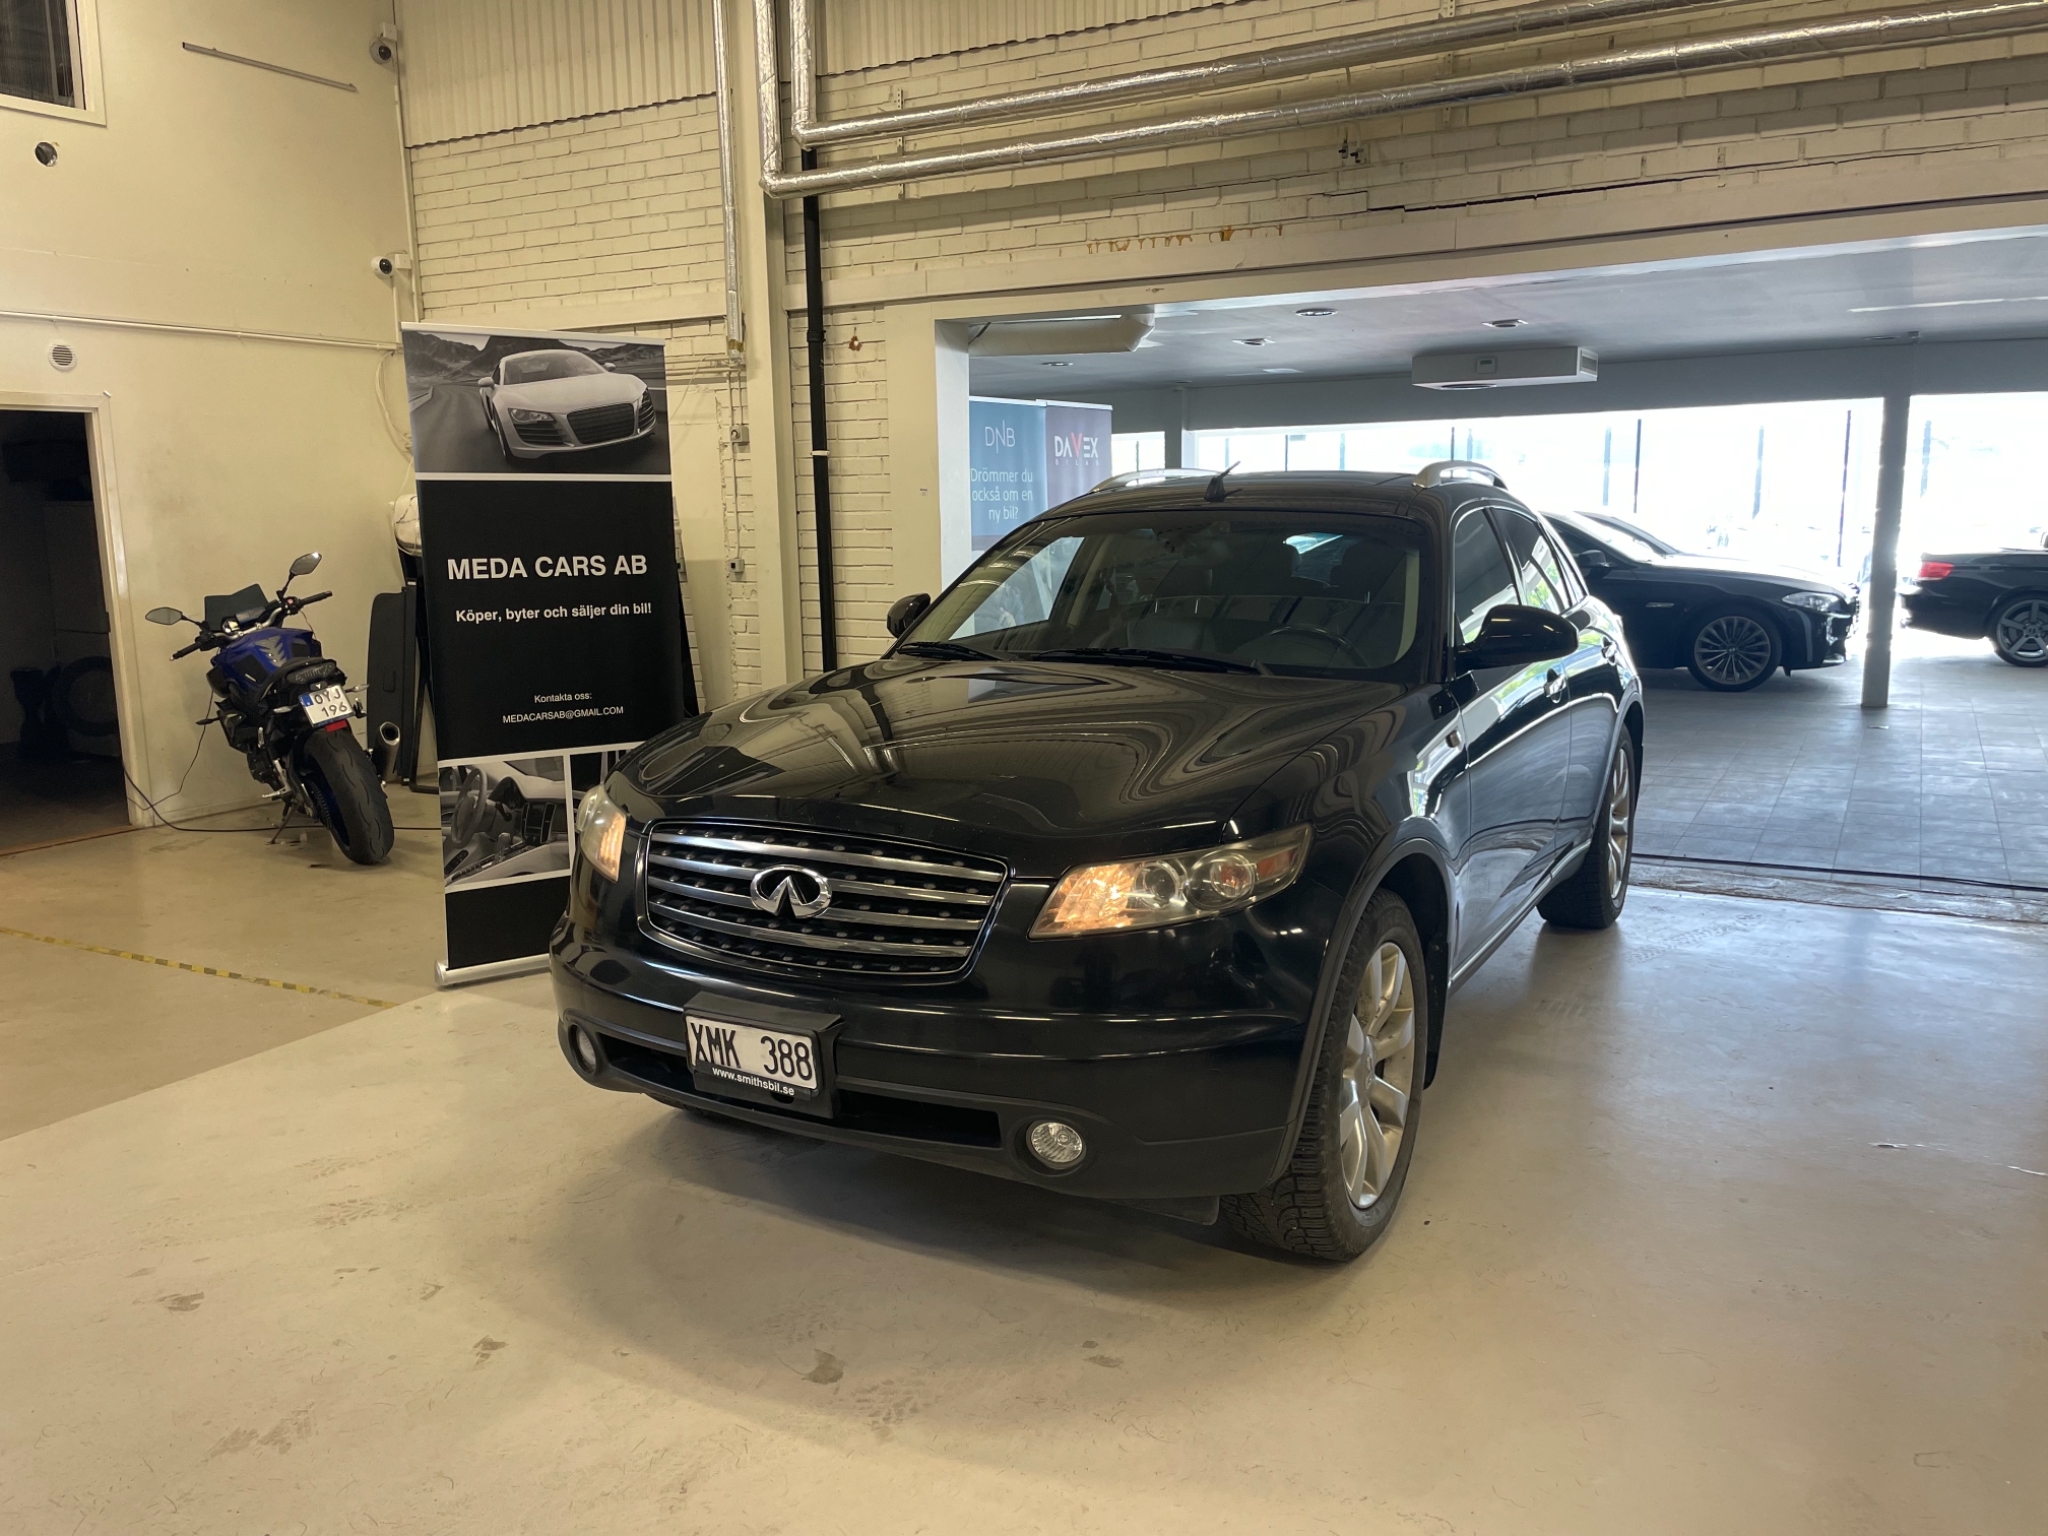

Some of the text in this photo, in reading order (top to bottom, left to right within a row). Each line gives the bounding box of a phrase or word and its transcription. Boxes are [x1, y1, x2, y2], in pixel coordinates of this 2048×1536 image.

[985, 420, 1016, 454] DNB
[1054, 432, 1099, 458] DAVEX
[970, 467, 1033, 482] Drömmer du
[972, 485, 1033, 501] också om en
[988, 505, 1019, 524] ny bil?
[447, 554, 648, 580] MEDA CARS AB
[455, 602, 652, 624] Köper, byter och säljer din bil!
[314, 688, 341, 705] OYJ
[534, 692, 593, 703] Kontakta oss:
[321, 702, 348, 718] 196
[502, 706, 624, 724] MEDACARSAB@GMAIL.COM
[690, 1022, 813, 1081] XMK 388
[712, 1067, 795, 1096] www.smithsbil.se
